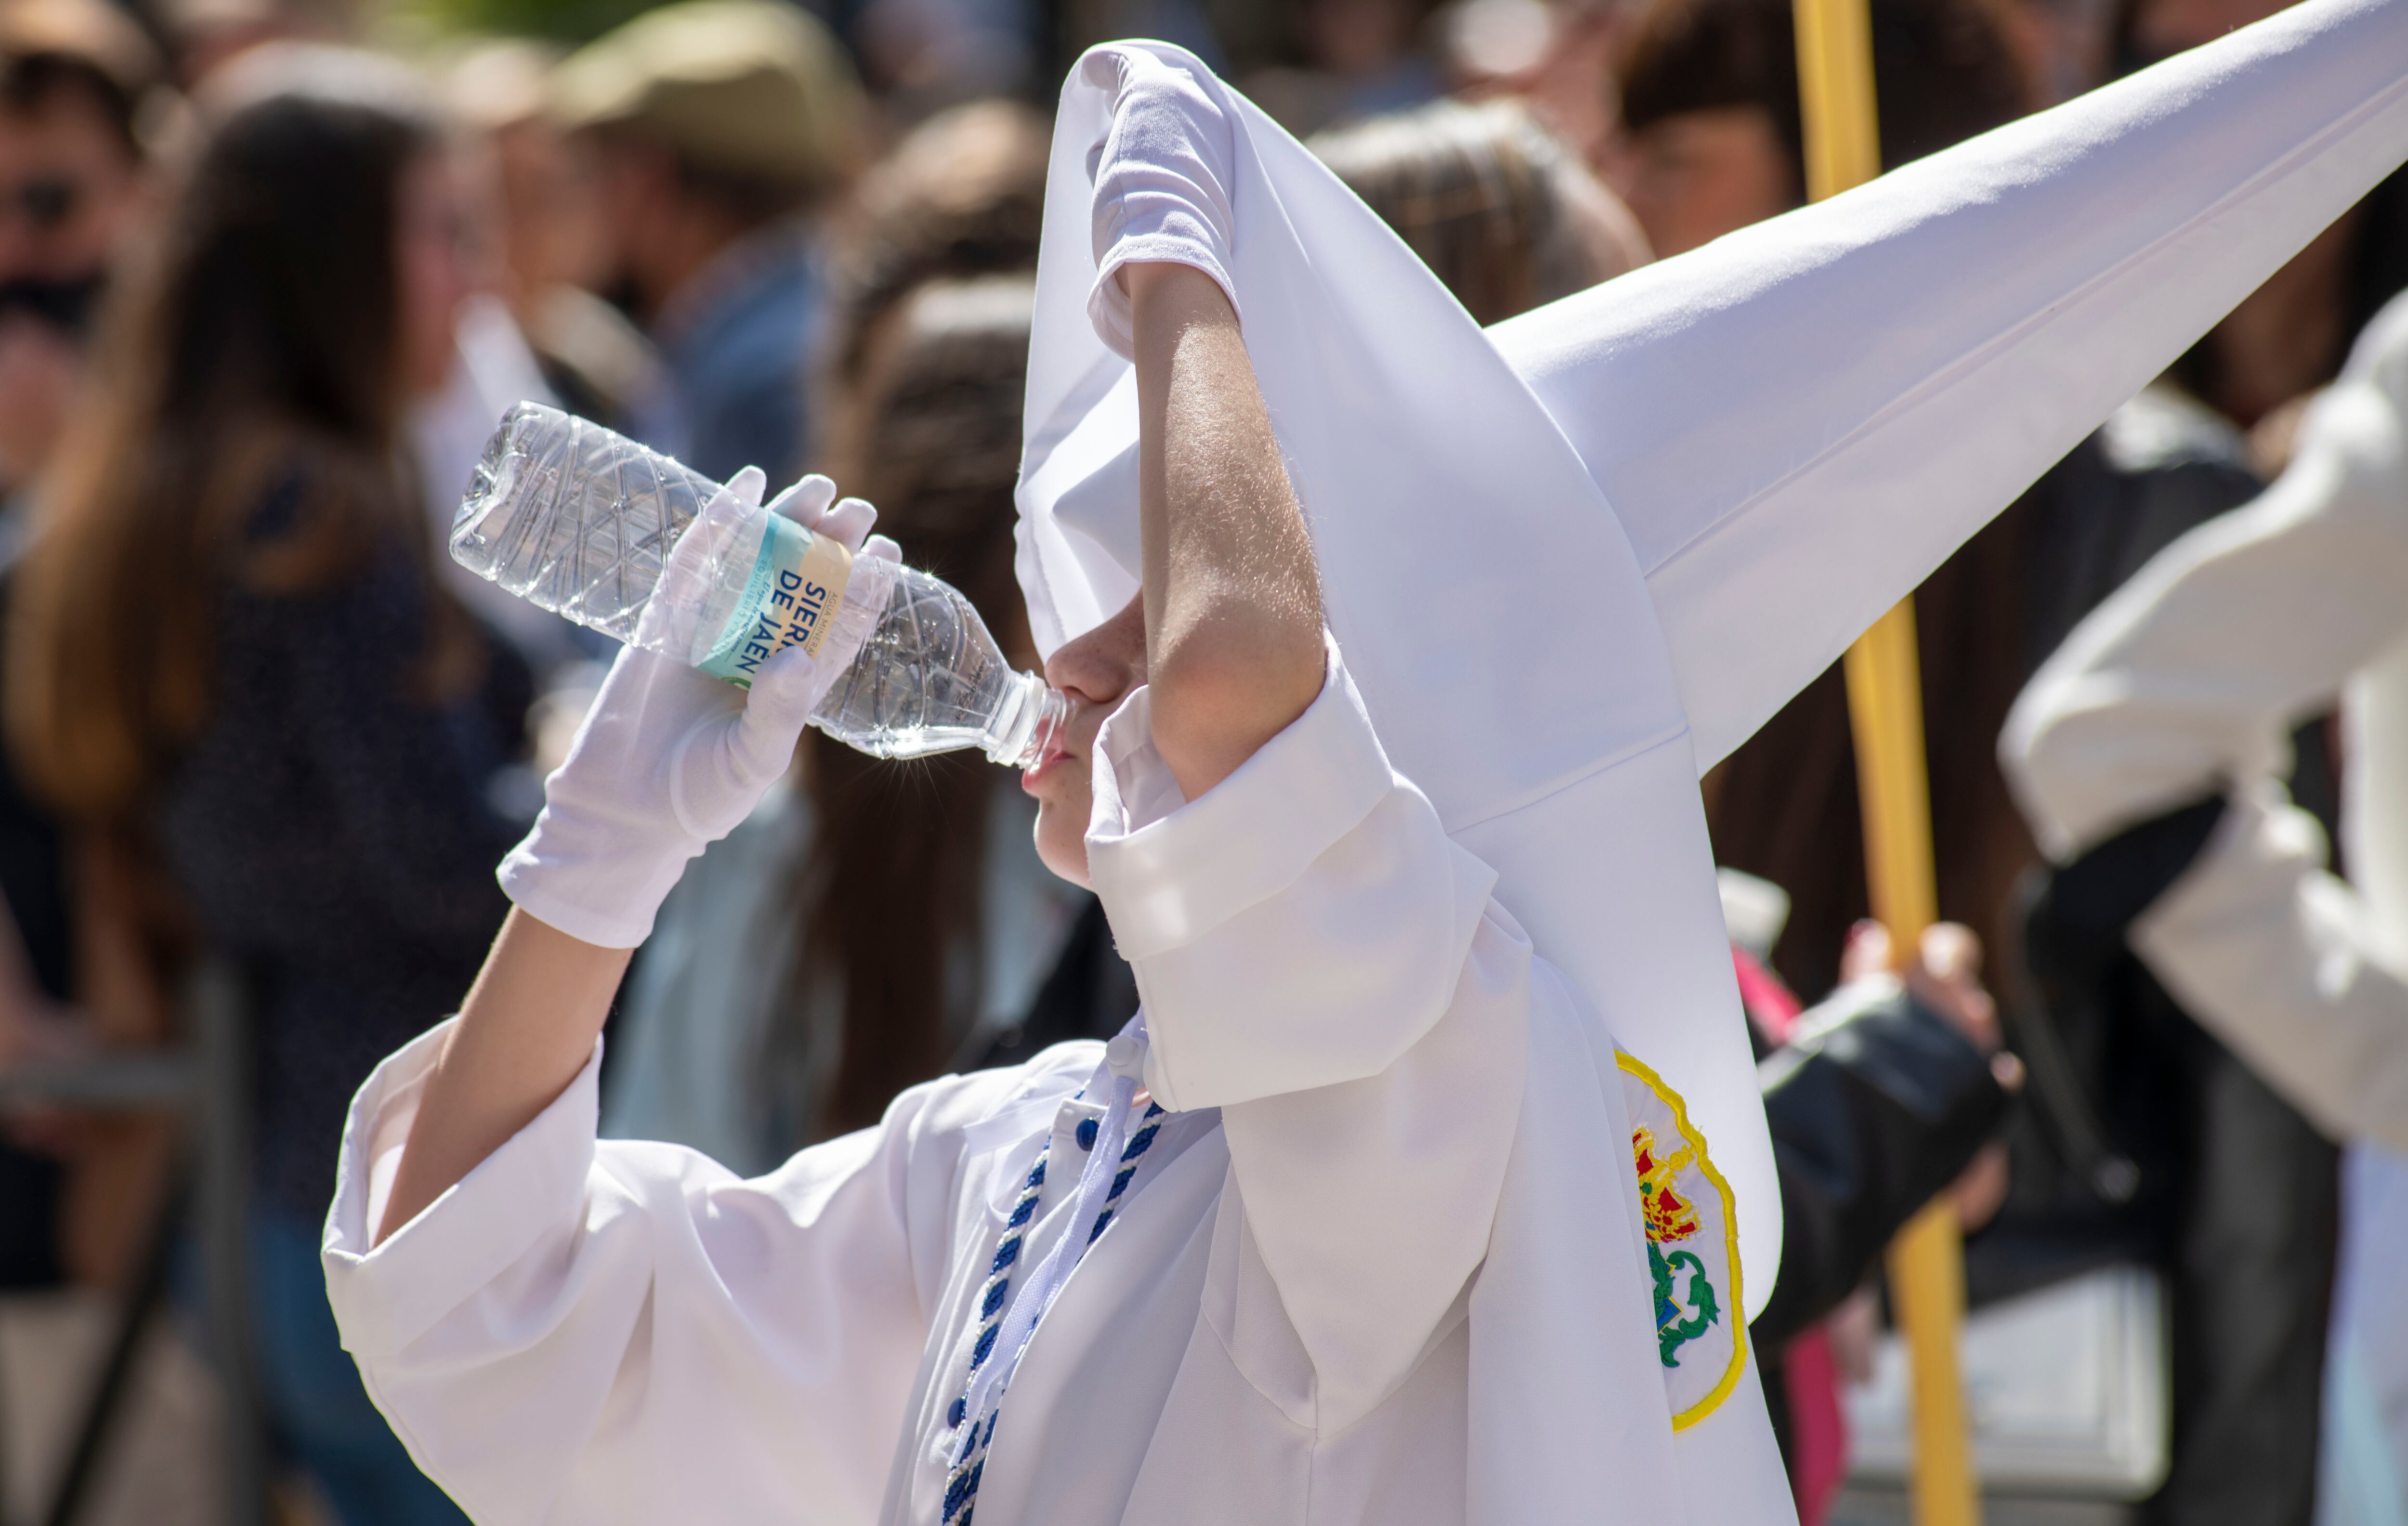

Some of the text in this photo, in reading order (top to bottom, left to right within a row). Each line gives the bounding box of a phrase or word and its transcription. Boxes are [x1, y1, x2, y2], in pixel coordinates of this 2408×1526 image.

[738, 560, 767, 617] EQUILIBRIO
[756, 590, 765, 605] agua
[763, 581, 771, 592] El
[771, 569, 802, 611] DE
[824, 591, 838, 616] AGUA
[740, 614, 754, 637] nuestra
